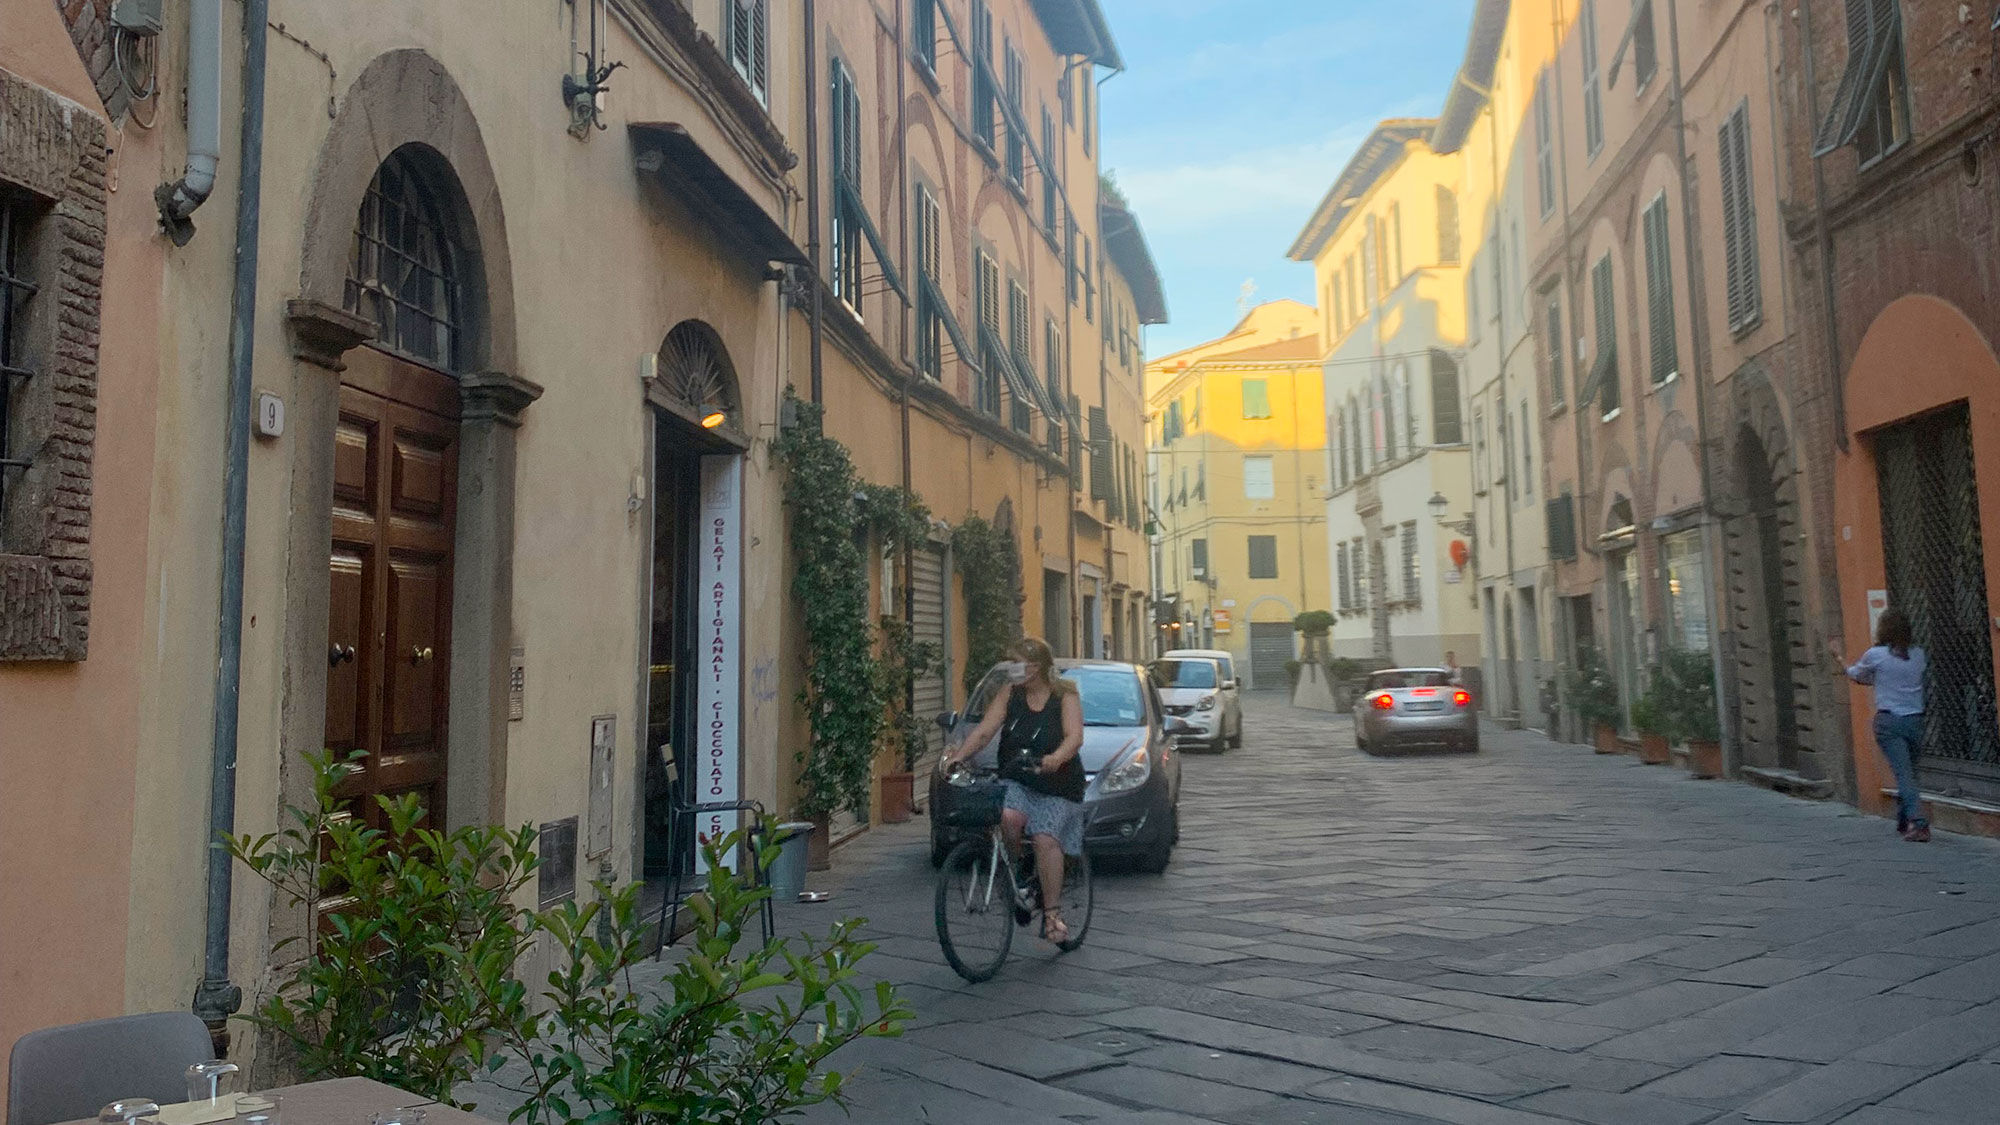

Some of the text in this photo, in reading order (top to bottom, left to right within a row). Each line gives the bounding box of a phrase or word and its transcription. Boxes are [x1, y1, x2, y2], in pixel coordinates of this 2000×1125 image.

[268, 402, 276, 429] 9
[712, 518, 725, 571] GELATI
[712, 582, 724, 682] ARTIGIANALI
[710, 701, 723, 795] CIOCCOLATO
